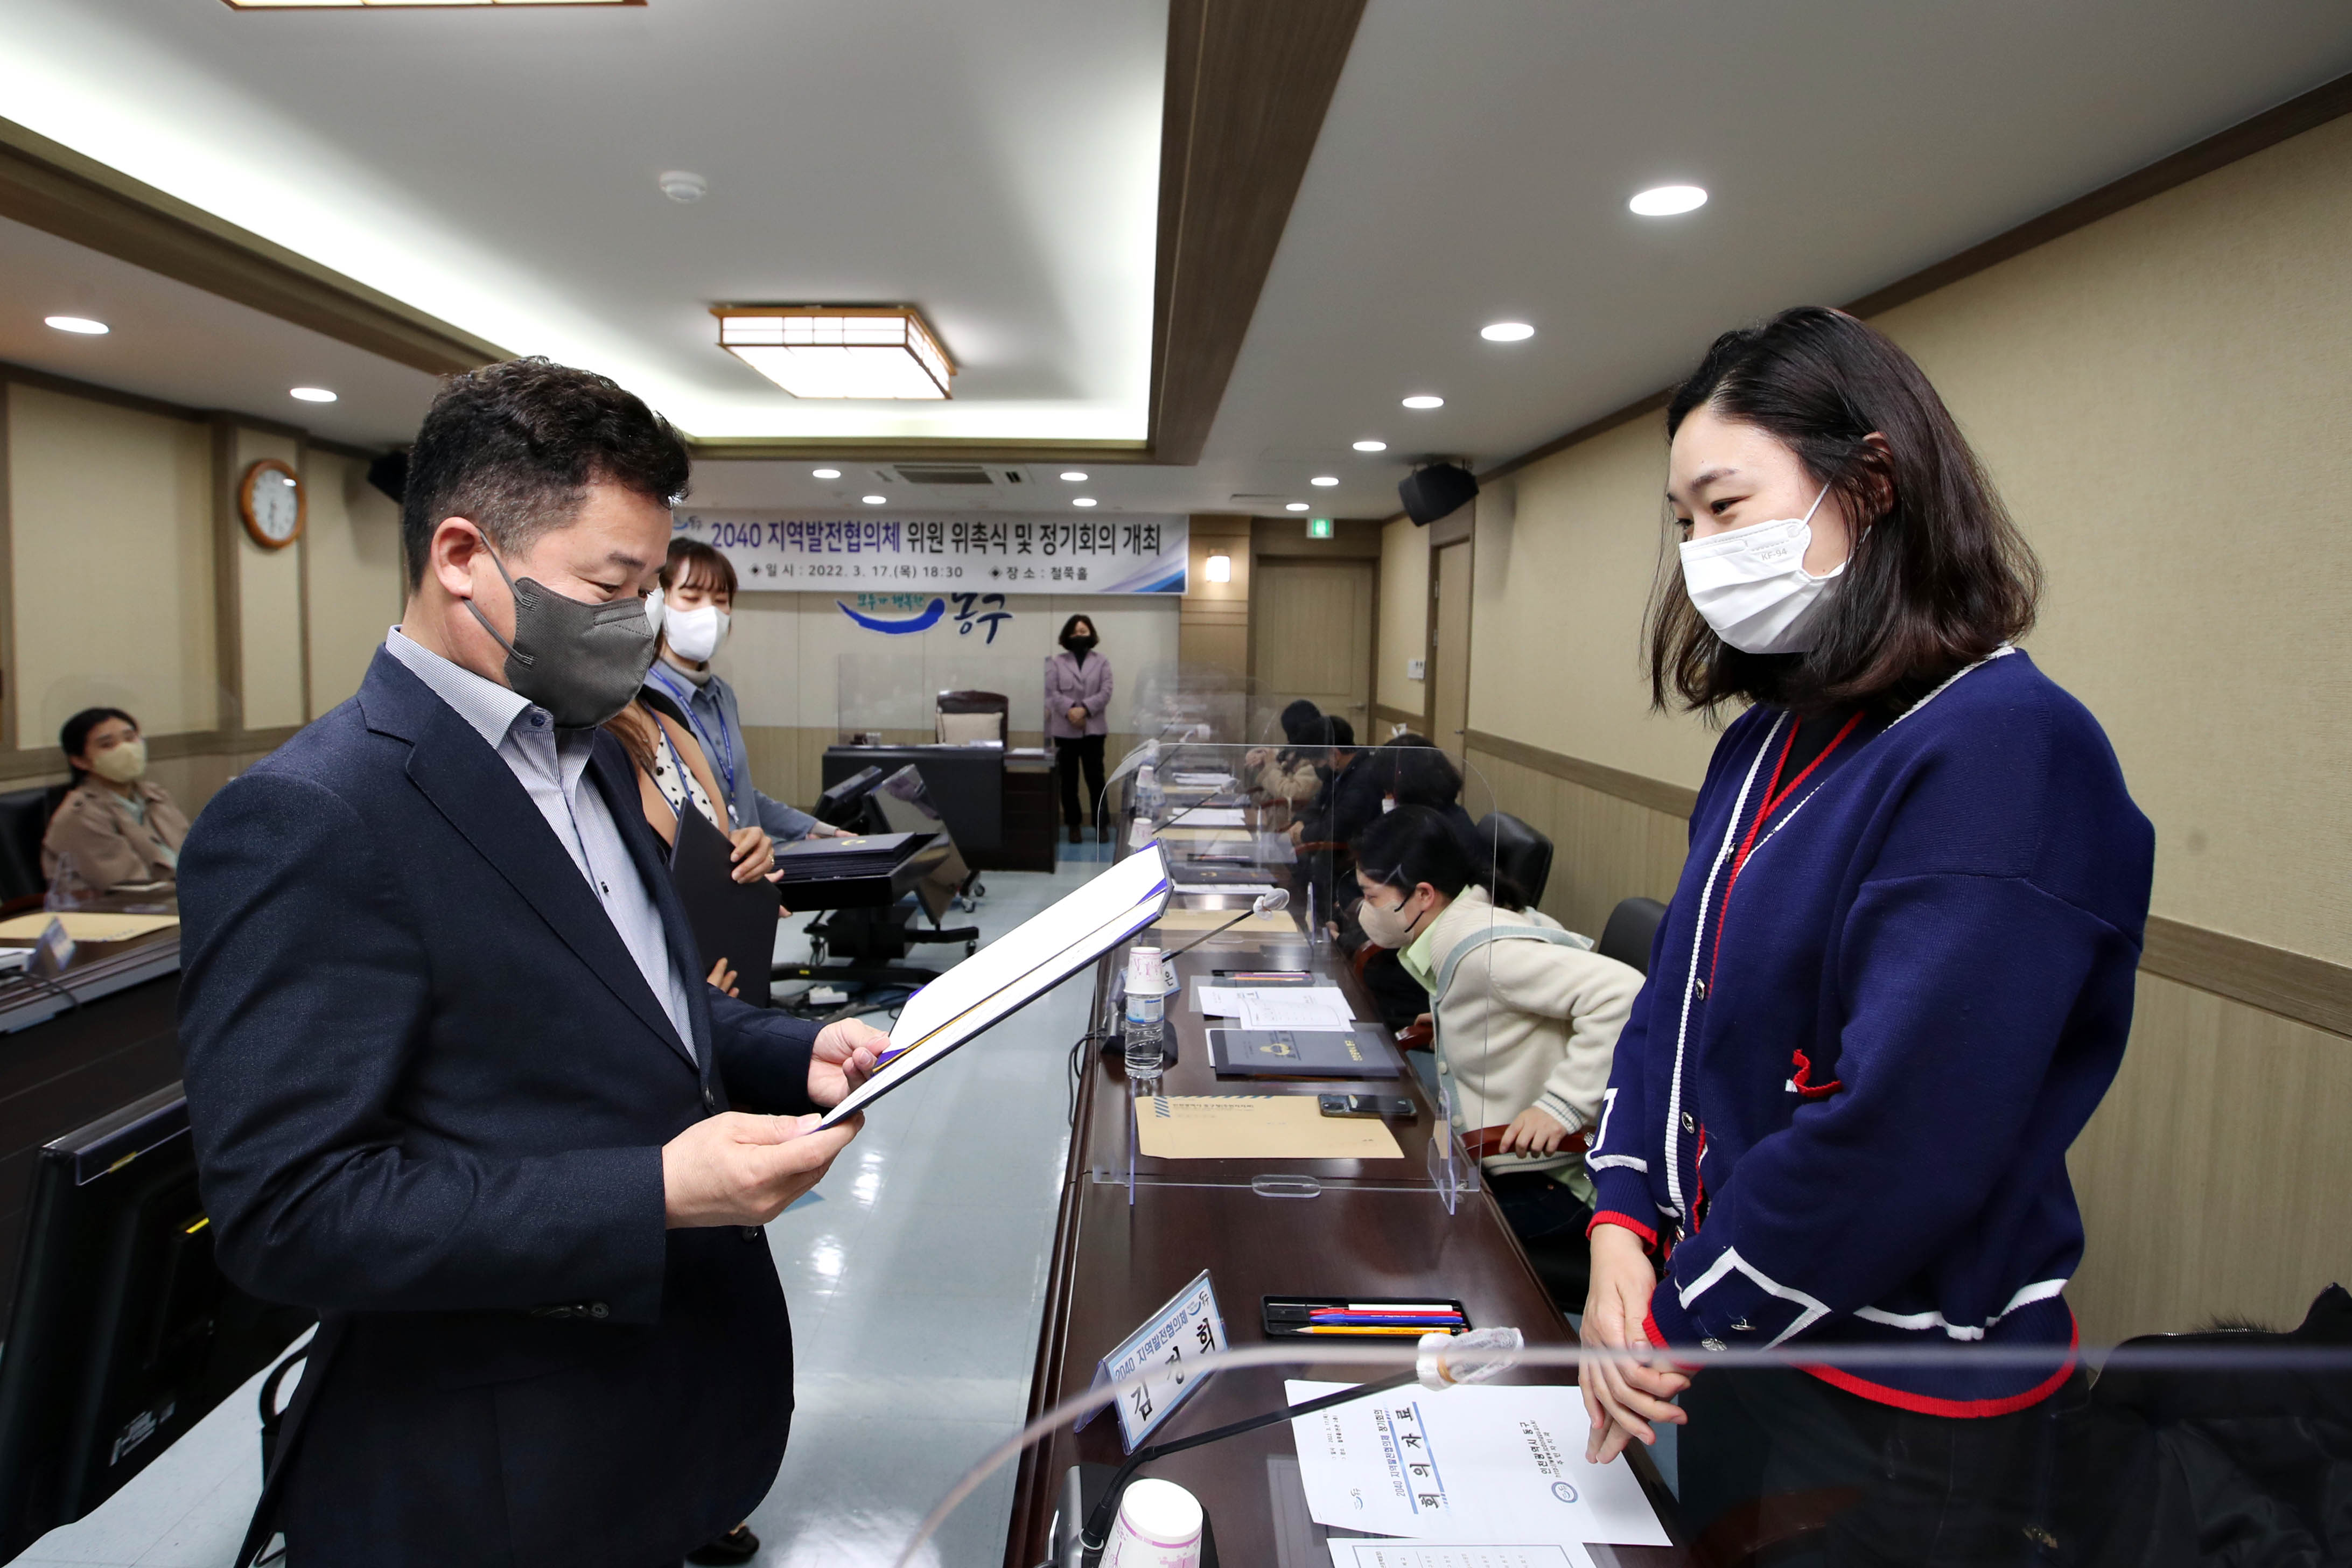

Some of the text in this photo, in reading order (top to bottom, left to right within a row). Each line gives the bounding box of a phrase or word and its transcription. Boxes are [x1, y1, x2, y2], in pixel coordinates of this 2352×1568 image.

[710, 520, 1161, 556] 2040 지역발전협의체 위원 위촉식 및 정기회의 개최
[1761, 548, 1788, 561] KF-94
[923, 565, 963, 578] 18:30
[1051, 566, 1088, 581] 철쭉홀
[1115, 1310, 1188, 1382] 2040 지역발전협의체
[1374, 1409, 1406, 1497] 2040 지역발전협의체 정기회의
[1520, 1422, 1552, 1474] 인천광역시 동구
